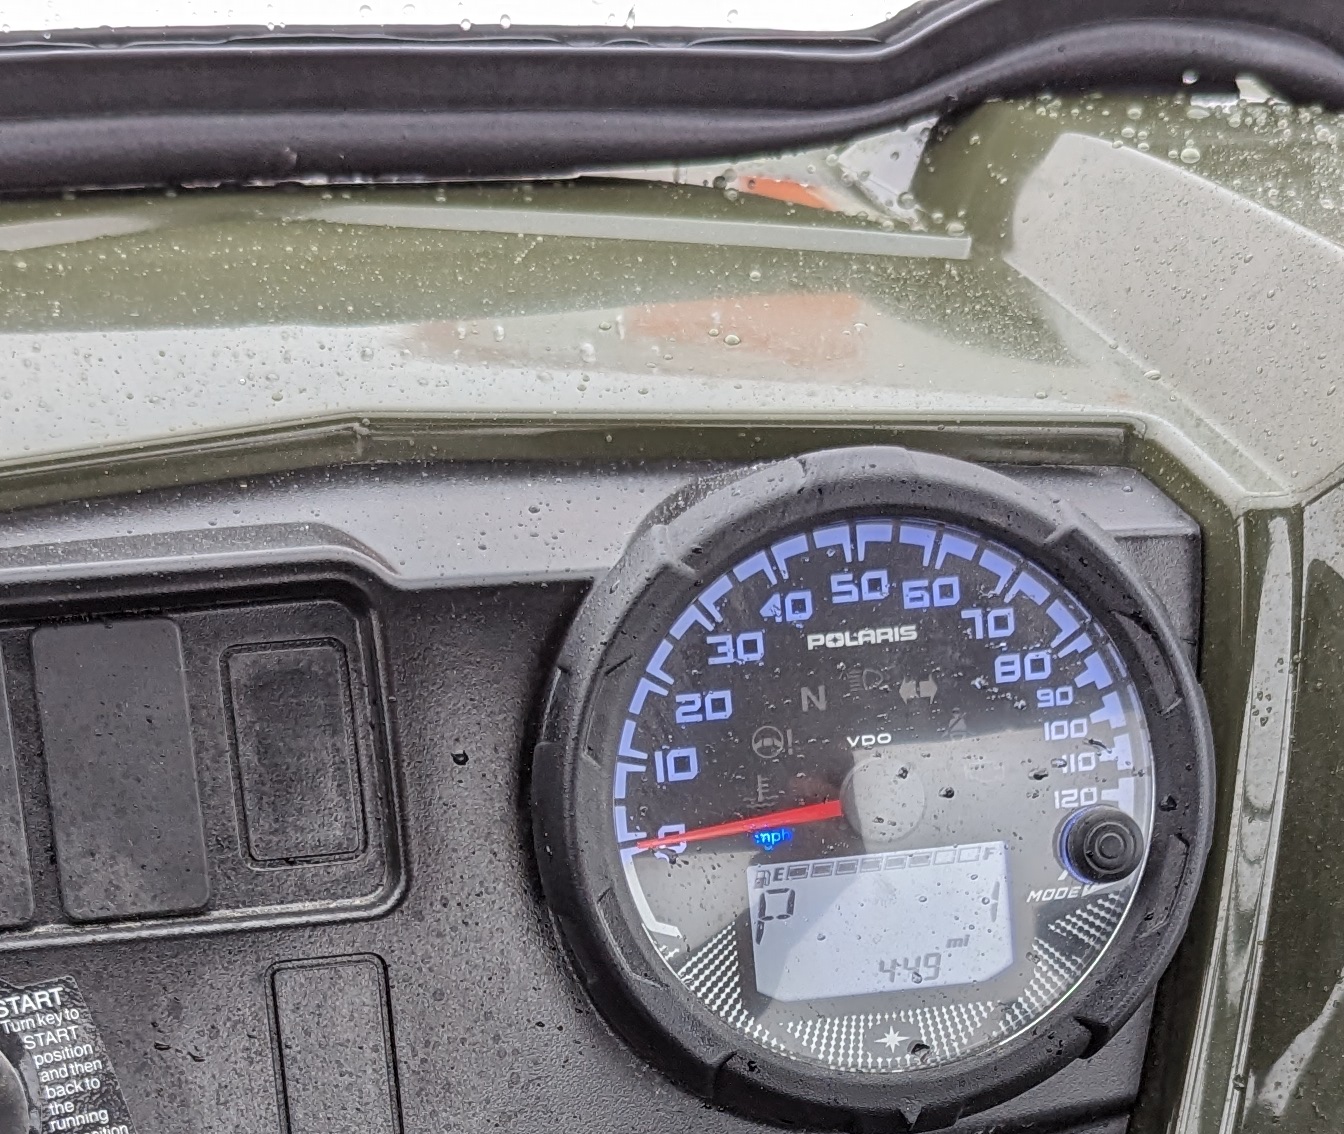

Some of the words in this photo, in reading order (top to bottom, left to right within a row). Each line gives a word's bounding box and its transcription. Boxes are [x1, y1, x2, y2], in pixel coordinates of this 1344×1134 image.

[830, 569, 889, 603] 50
[902, 576, 960, 609] 60
[759, 590, 813, 623] 40
[961, 607, 1015, 640] 70
[706, 630, 764, 665] 30
[807, 625, 917, 650] POLARIS
[994, 652, 1052, 684] 80
[675, 689, 733, 723] 20
[800, 685, 827, 712] N
[1036, 686, 1073, 708] 90
[847, 733, 892, 747] VDO
[1044, 718, 1088, 741] 100
[655, 748, 698, 783] 10
[1060, 752, 1097, 774] 110
[1054, 787, 1098, 809] 120
[773, 867, 784, 882] E
[1026, 886, 1081, 903] MODE
[946, 934, 970, 948] mi
[0, 1018, 36, 1035] Turn
[37, 1011, 63, 1029] key
[64, 1008, 80, 1021] to
[24, 1026, 79, 1050] START
[35, 1043, 94, 1069] position
[41, 1065, 69, 1083] and
[69, 1059, 103, 1078] then
[46, 1079, 84, 1100] back
[85, 1075, 101, 1091] to
[48, 1100, 75, 1116] the
[48, 1109, 110, 1133] running
